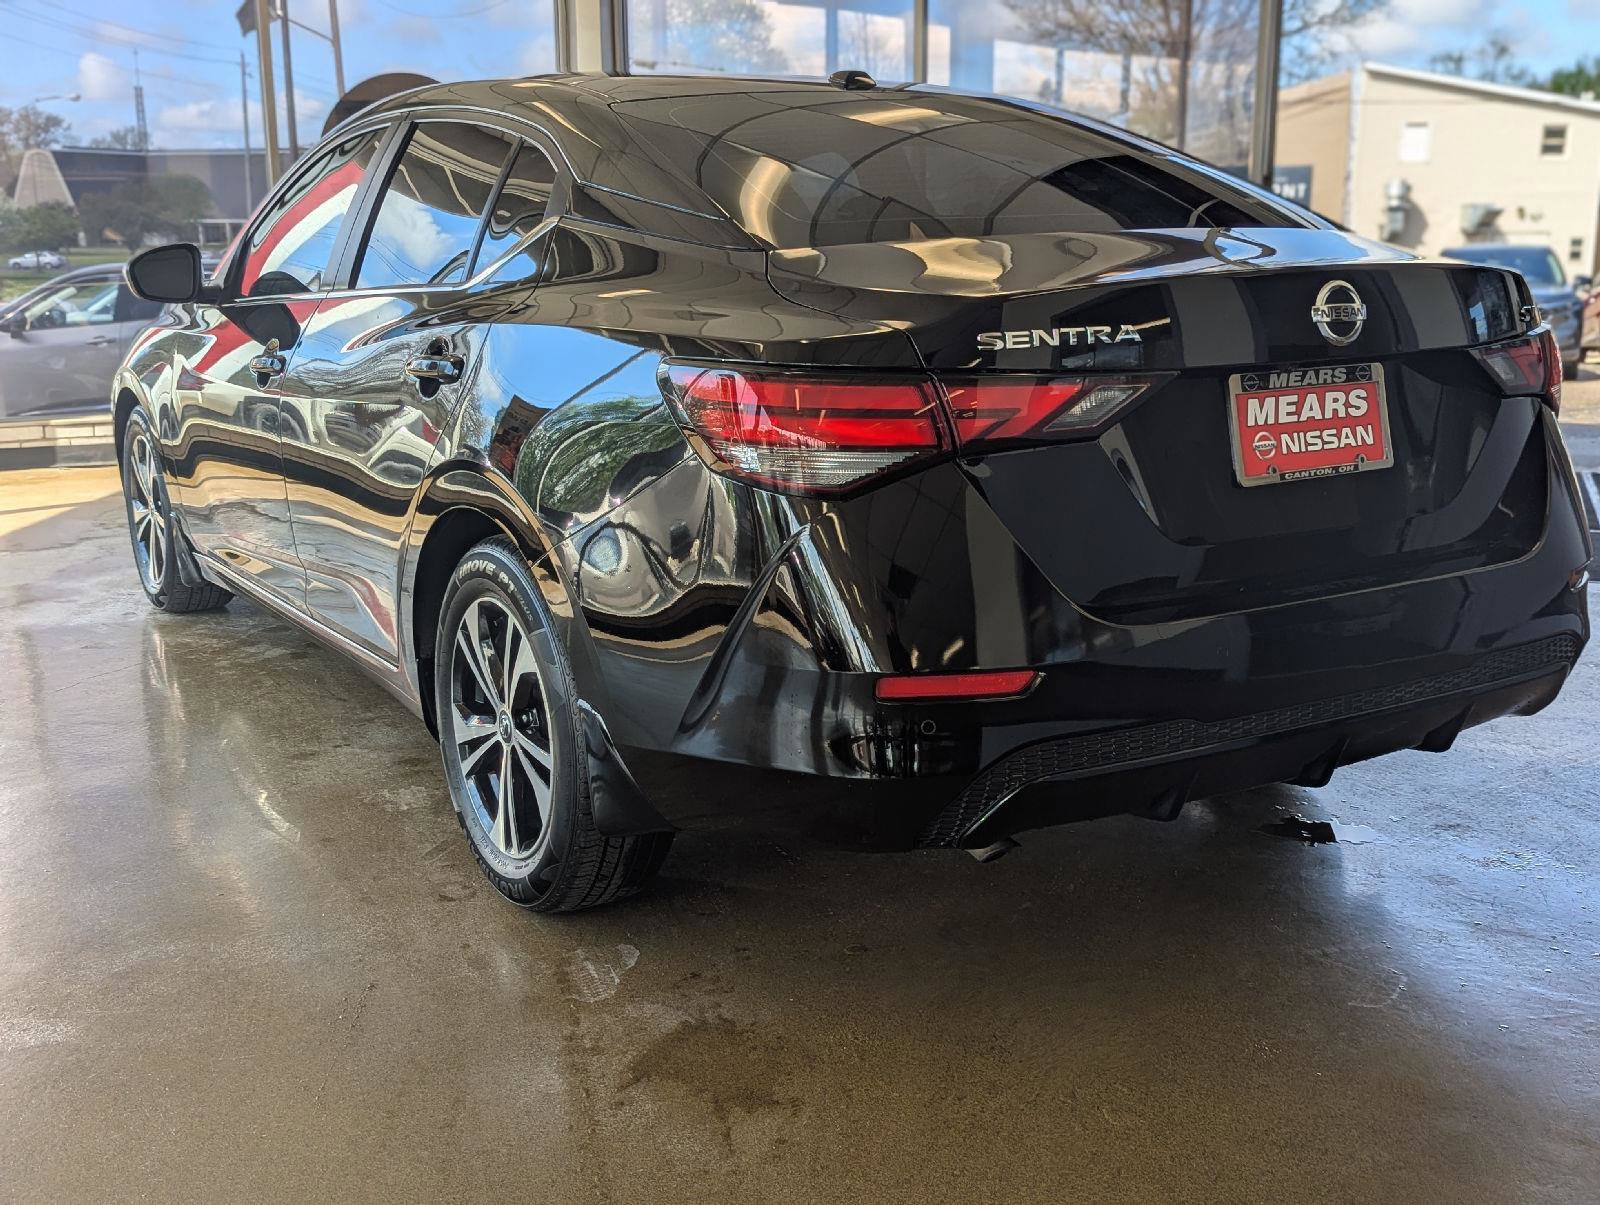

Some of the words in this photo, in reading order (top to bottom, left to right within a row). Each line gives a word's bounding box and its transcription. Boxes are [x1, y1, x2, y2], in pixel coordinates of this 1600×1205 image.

[1321, 307, 1364, 319] NISSAN
[976, 324, 1143, 351] SENTRA
[1268, 367, 1347, 389] MEARS
[1247, 388, 1368, 427] MEARS
[1280, 424, 1375, 455] NISSAN
[1284, 467, 1336, 480] CANTON,
[1338, 464, 1355, 473] OH
